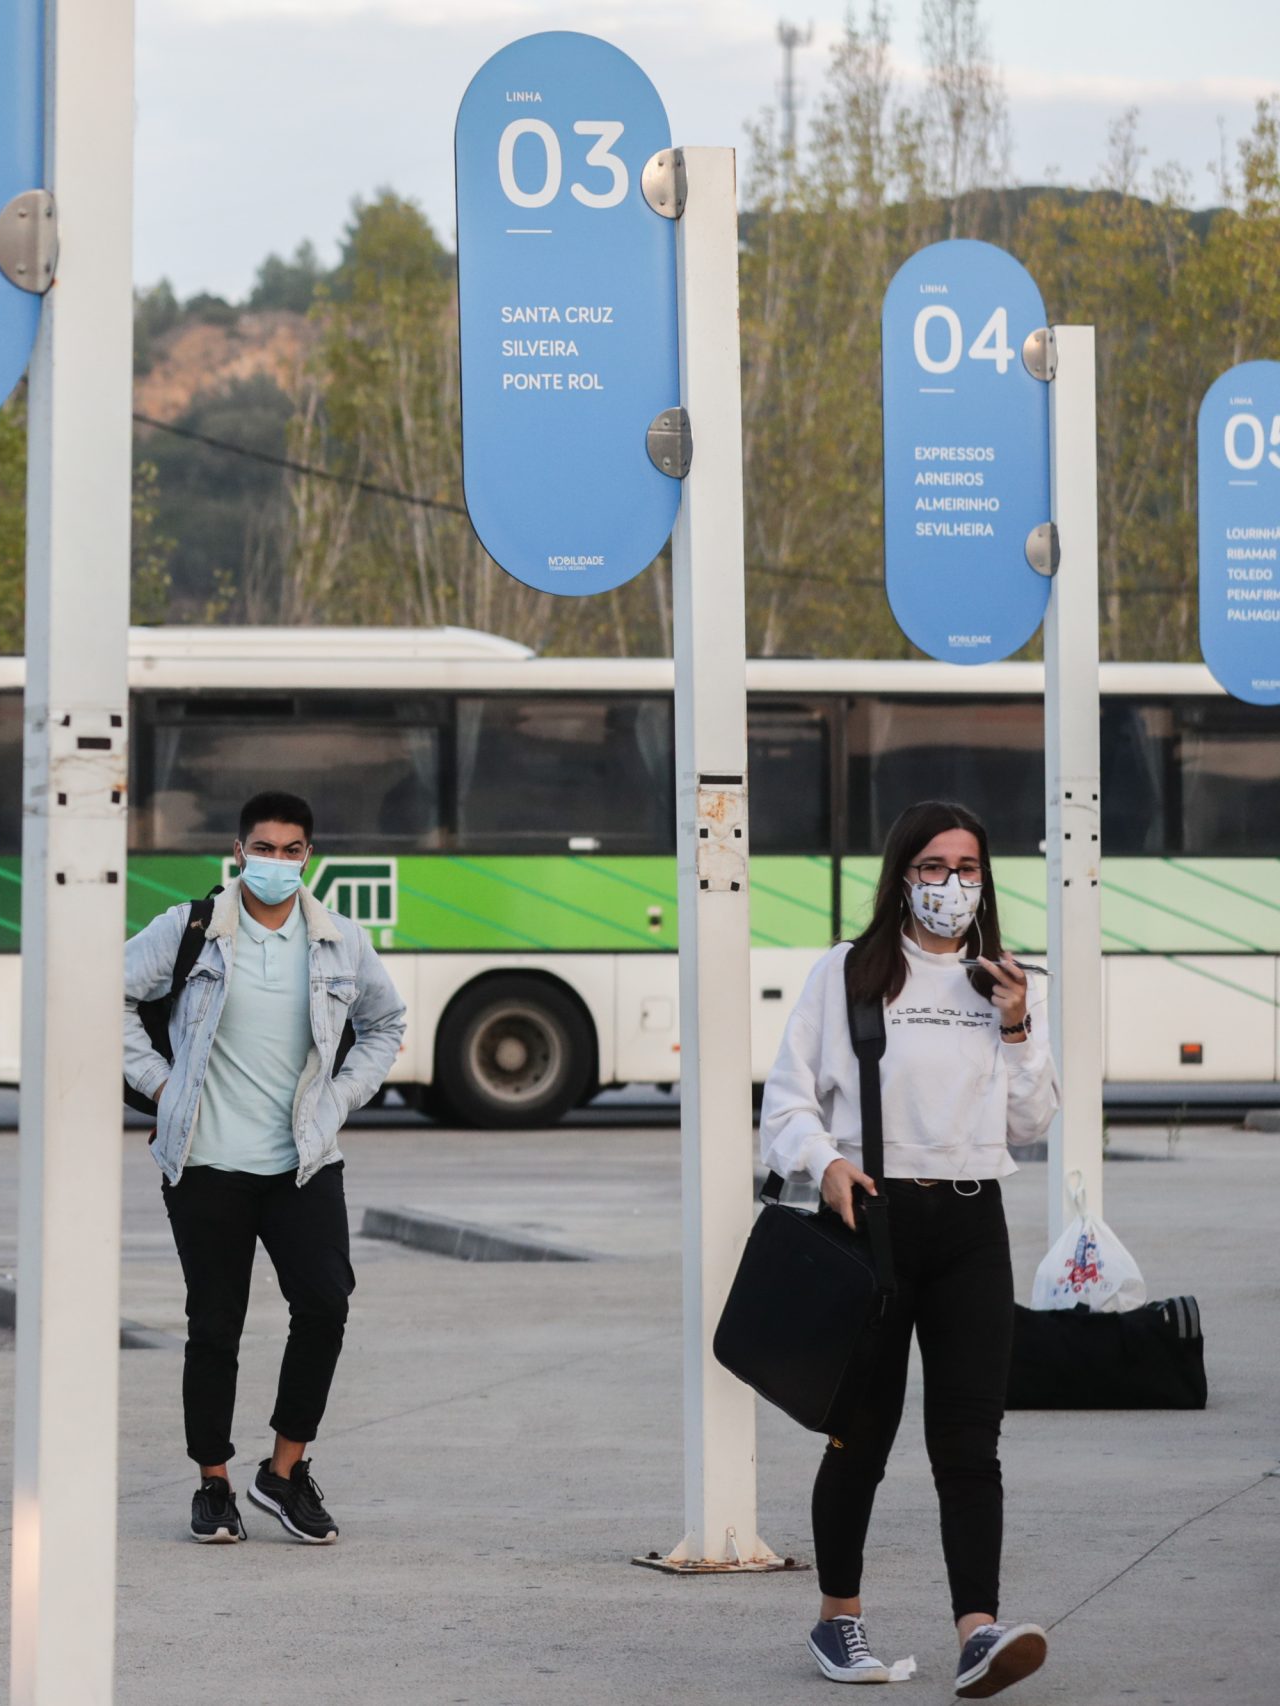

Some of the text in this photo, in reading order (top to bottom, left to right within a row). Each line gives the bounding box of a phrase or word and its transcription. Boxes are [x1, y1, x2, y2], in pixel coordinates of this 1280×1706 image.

[506, 91, 543, 102] LINHA
[498, 118, 629, 208] 03
[920, 284, 949, 294] LINHA
[501, 306, 614, 323] SANTA CRUZ
[913, 305, 1016, 374] 04
[501, 340, 579, 356] SILVEIRA
[502, 373, 604, 390] PONTE ROL
[915, 446, 995, 461] EXPRESSOS
[914, 471, 984, 486] ARNEIROS
[915, 496, 1000, 512] ALMEIRINHO
[915, 521, 994, 537] SEVILHEIRA
[1226, 547, 1277, 561] RIBAMAR
[1227, 567, 1273, 581] TOLEDO
